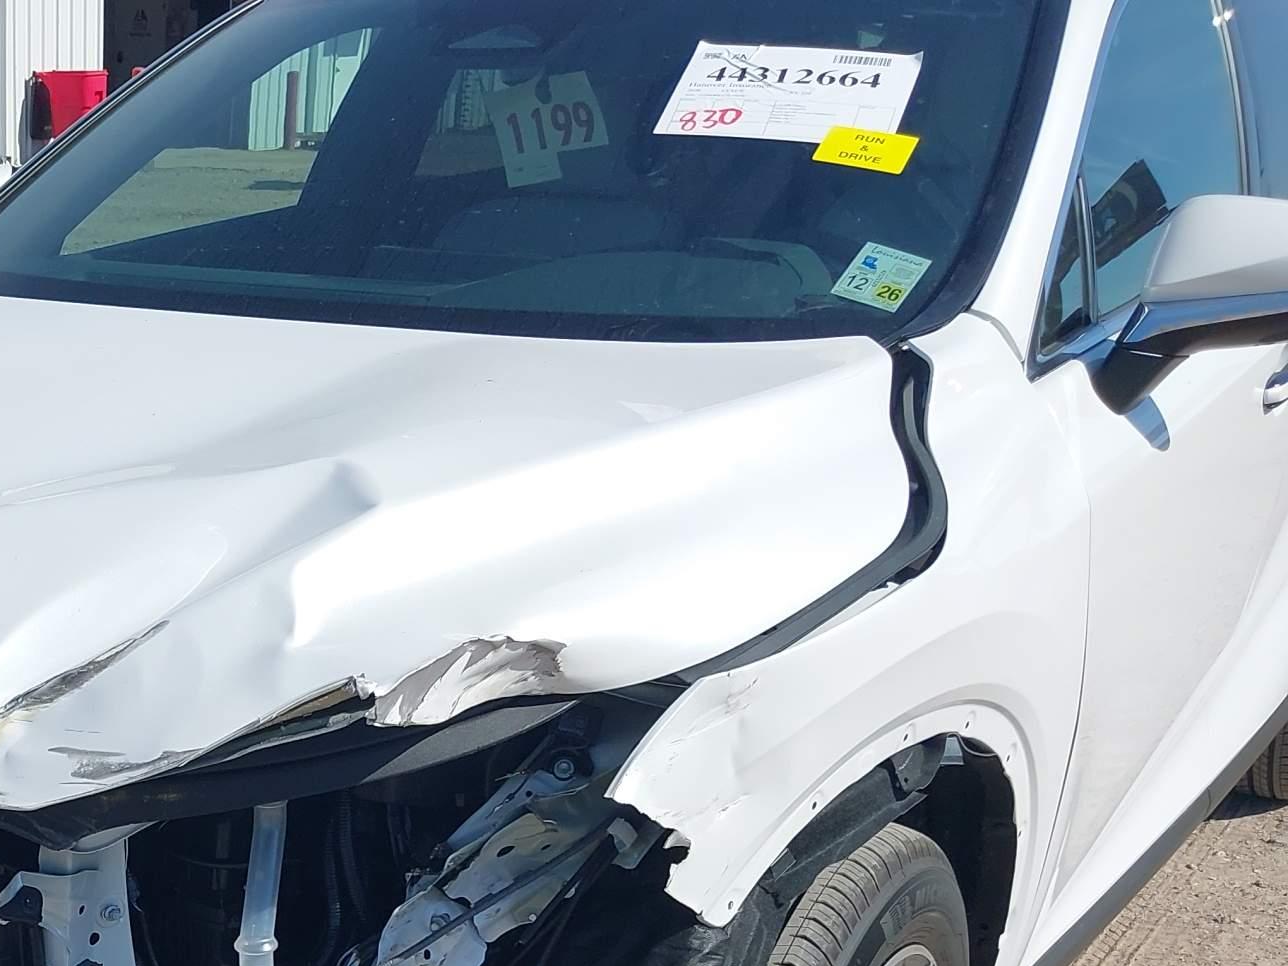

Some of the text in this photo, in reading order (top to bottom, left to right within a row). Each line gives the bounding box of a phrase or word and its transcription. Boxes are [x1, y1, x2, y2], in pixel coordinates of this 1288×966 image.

[706, 65, 882, 89] 44312664
[505, 101, 595, 154] 1199
[679, 107, 743, 132] 830
[854, 134, 886, 145] RUN
[859, 144, 869, 152] &
[838, 151, 883, 164] DRIVE
[871, 245, 924, 267] Louisiana
[846, 274, 869, 291] 12
[876, 285, 902, 302] 26
